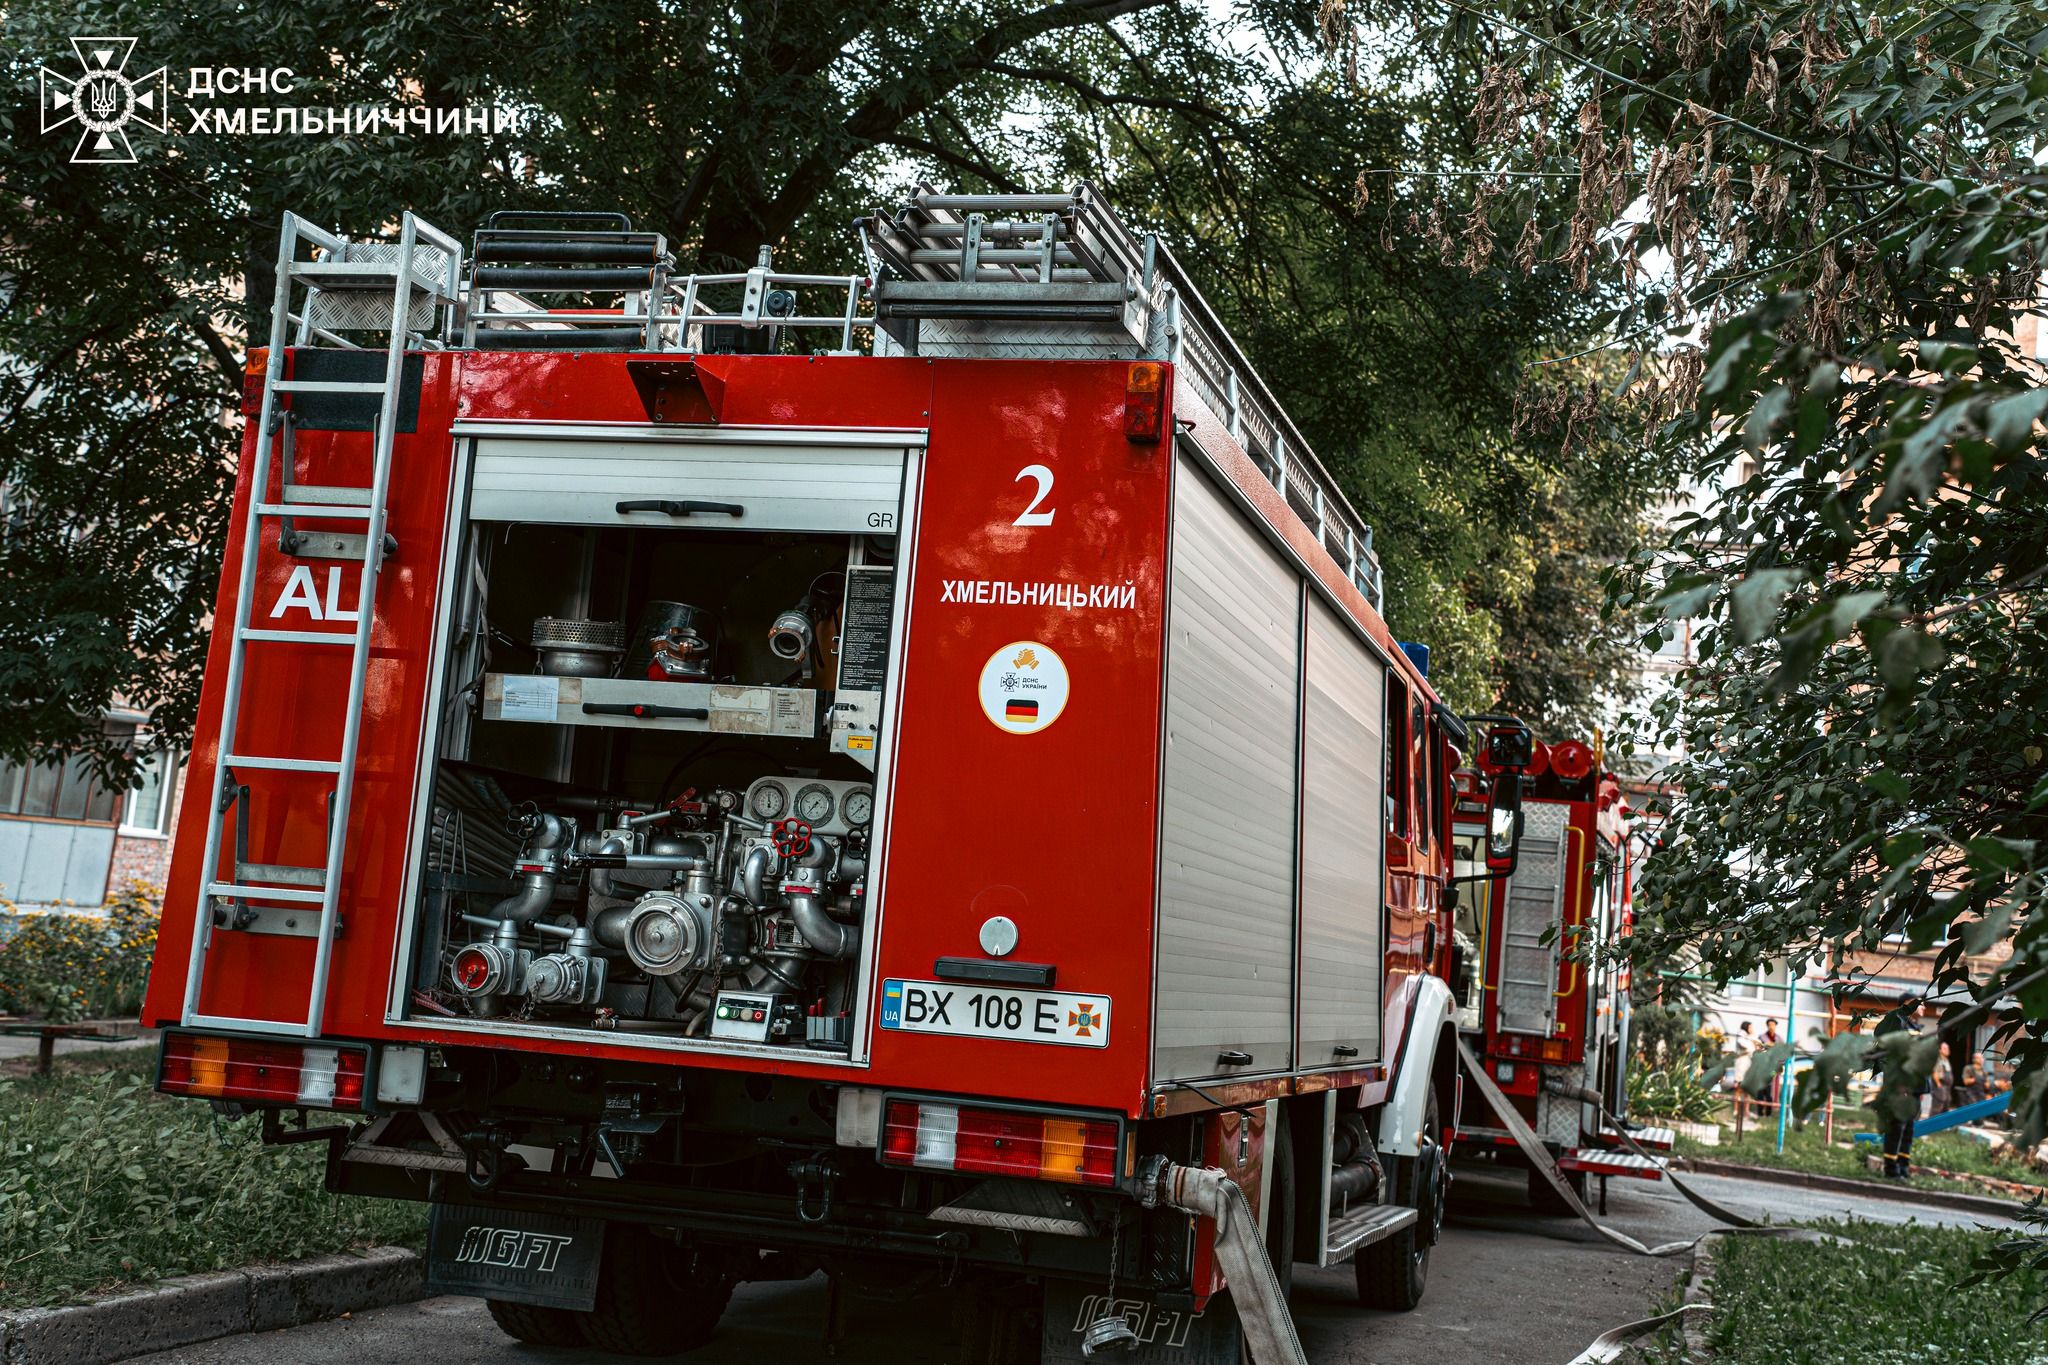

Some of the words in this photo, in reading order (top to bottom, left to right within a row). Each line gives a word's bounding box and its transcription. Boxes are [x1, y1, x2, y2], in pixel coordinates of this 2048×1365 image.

[1012, 463, 1056, 526] 2
[867, 512, 893, 528] GR
[269, 566, 365, 622] AL
[940, 579, 1137, 611] ХМЕЛЬНИЦЬКИЙ
[884, 1010, 899, 1022] UA
[967, 993, 1023, 1031] 108
[1034, 998, 1059, 1034] E
